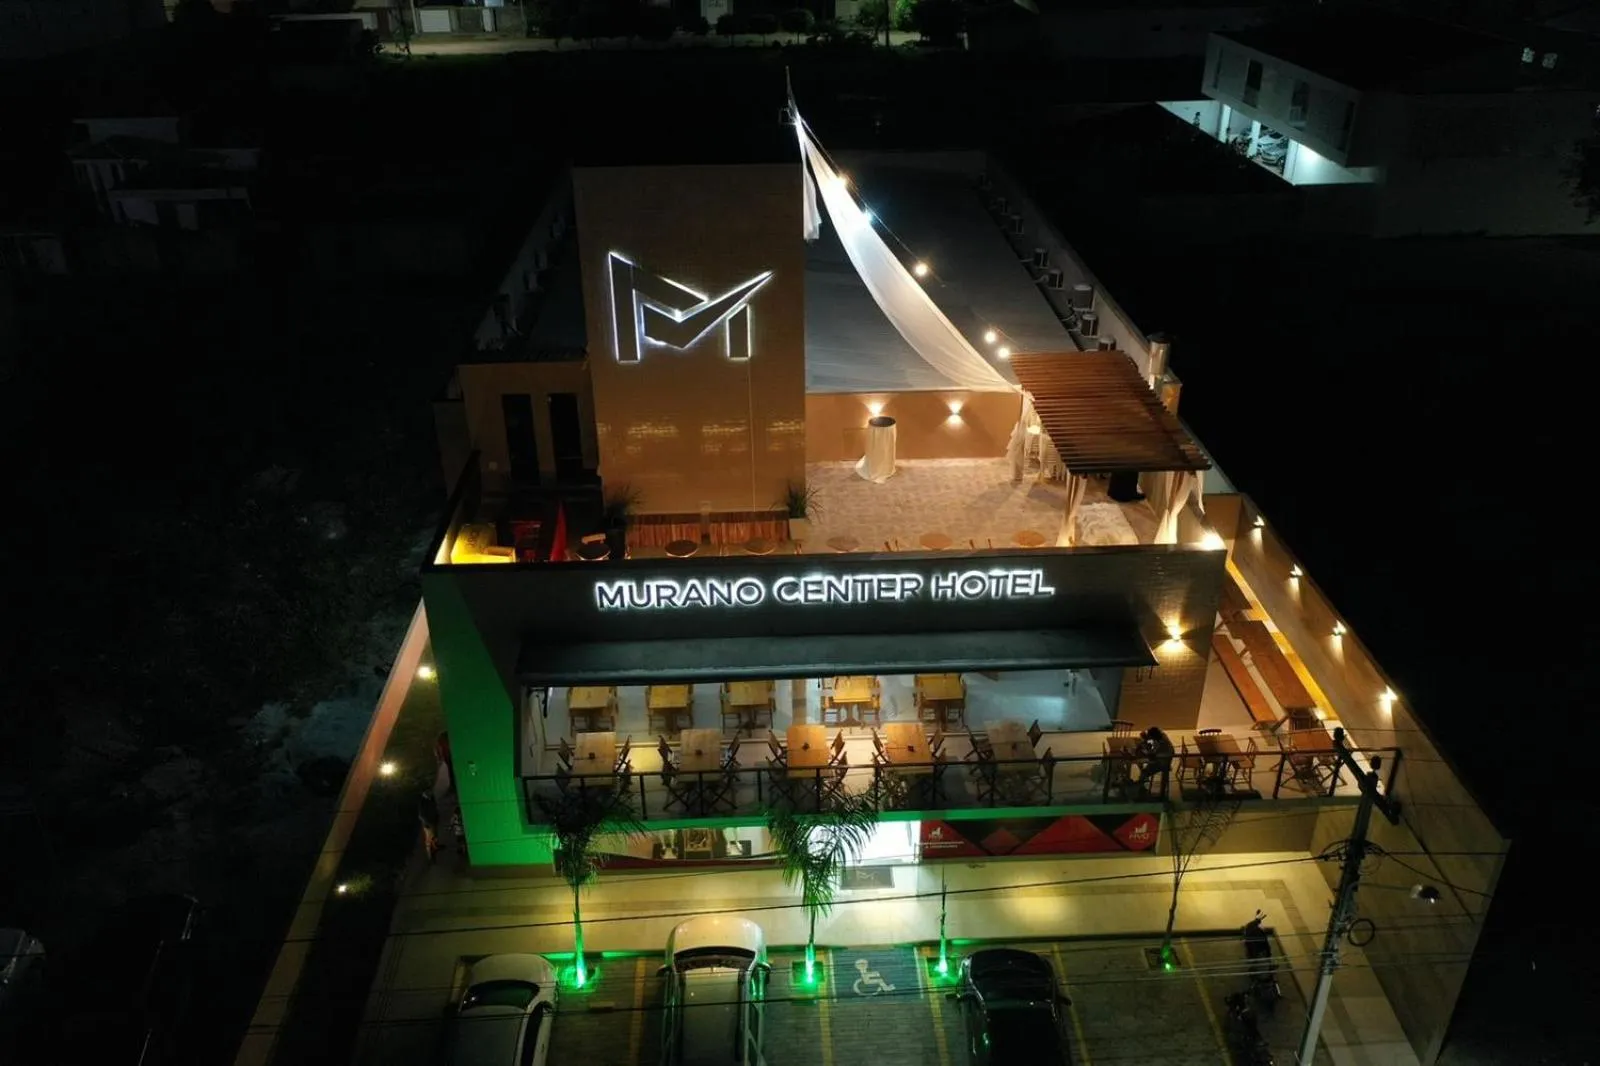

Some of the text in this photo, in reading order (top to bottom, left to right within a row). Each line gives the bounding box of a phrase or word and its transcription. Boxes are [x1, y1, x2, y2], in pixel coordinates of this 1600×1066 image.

[594, 568, 1056, 611] MURANO CENTER HOTEL
